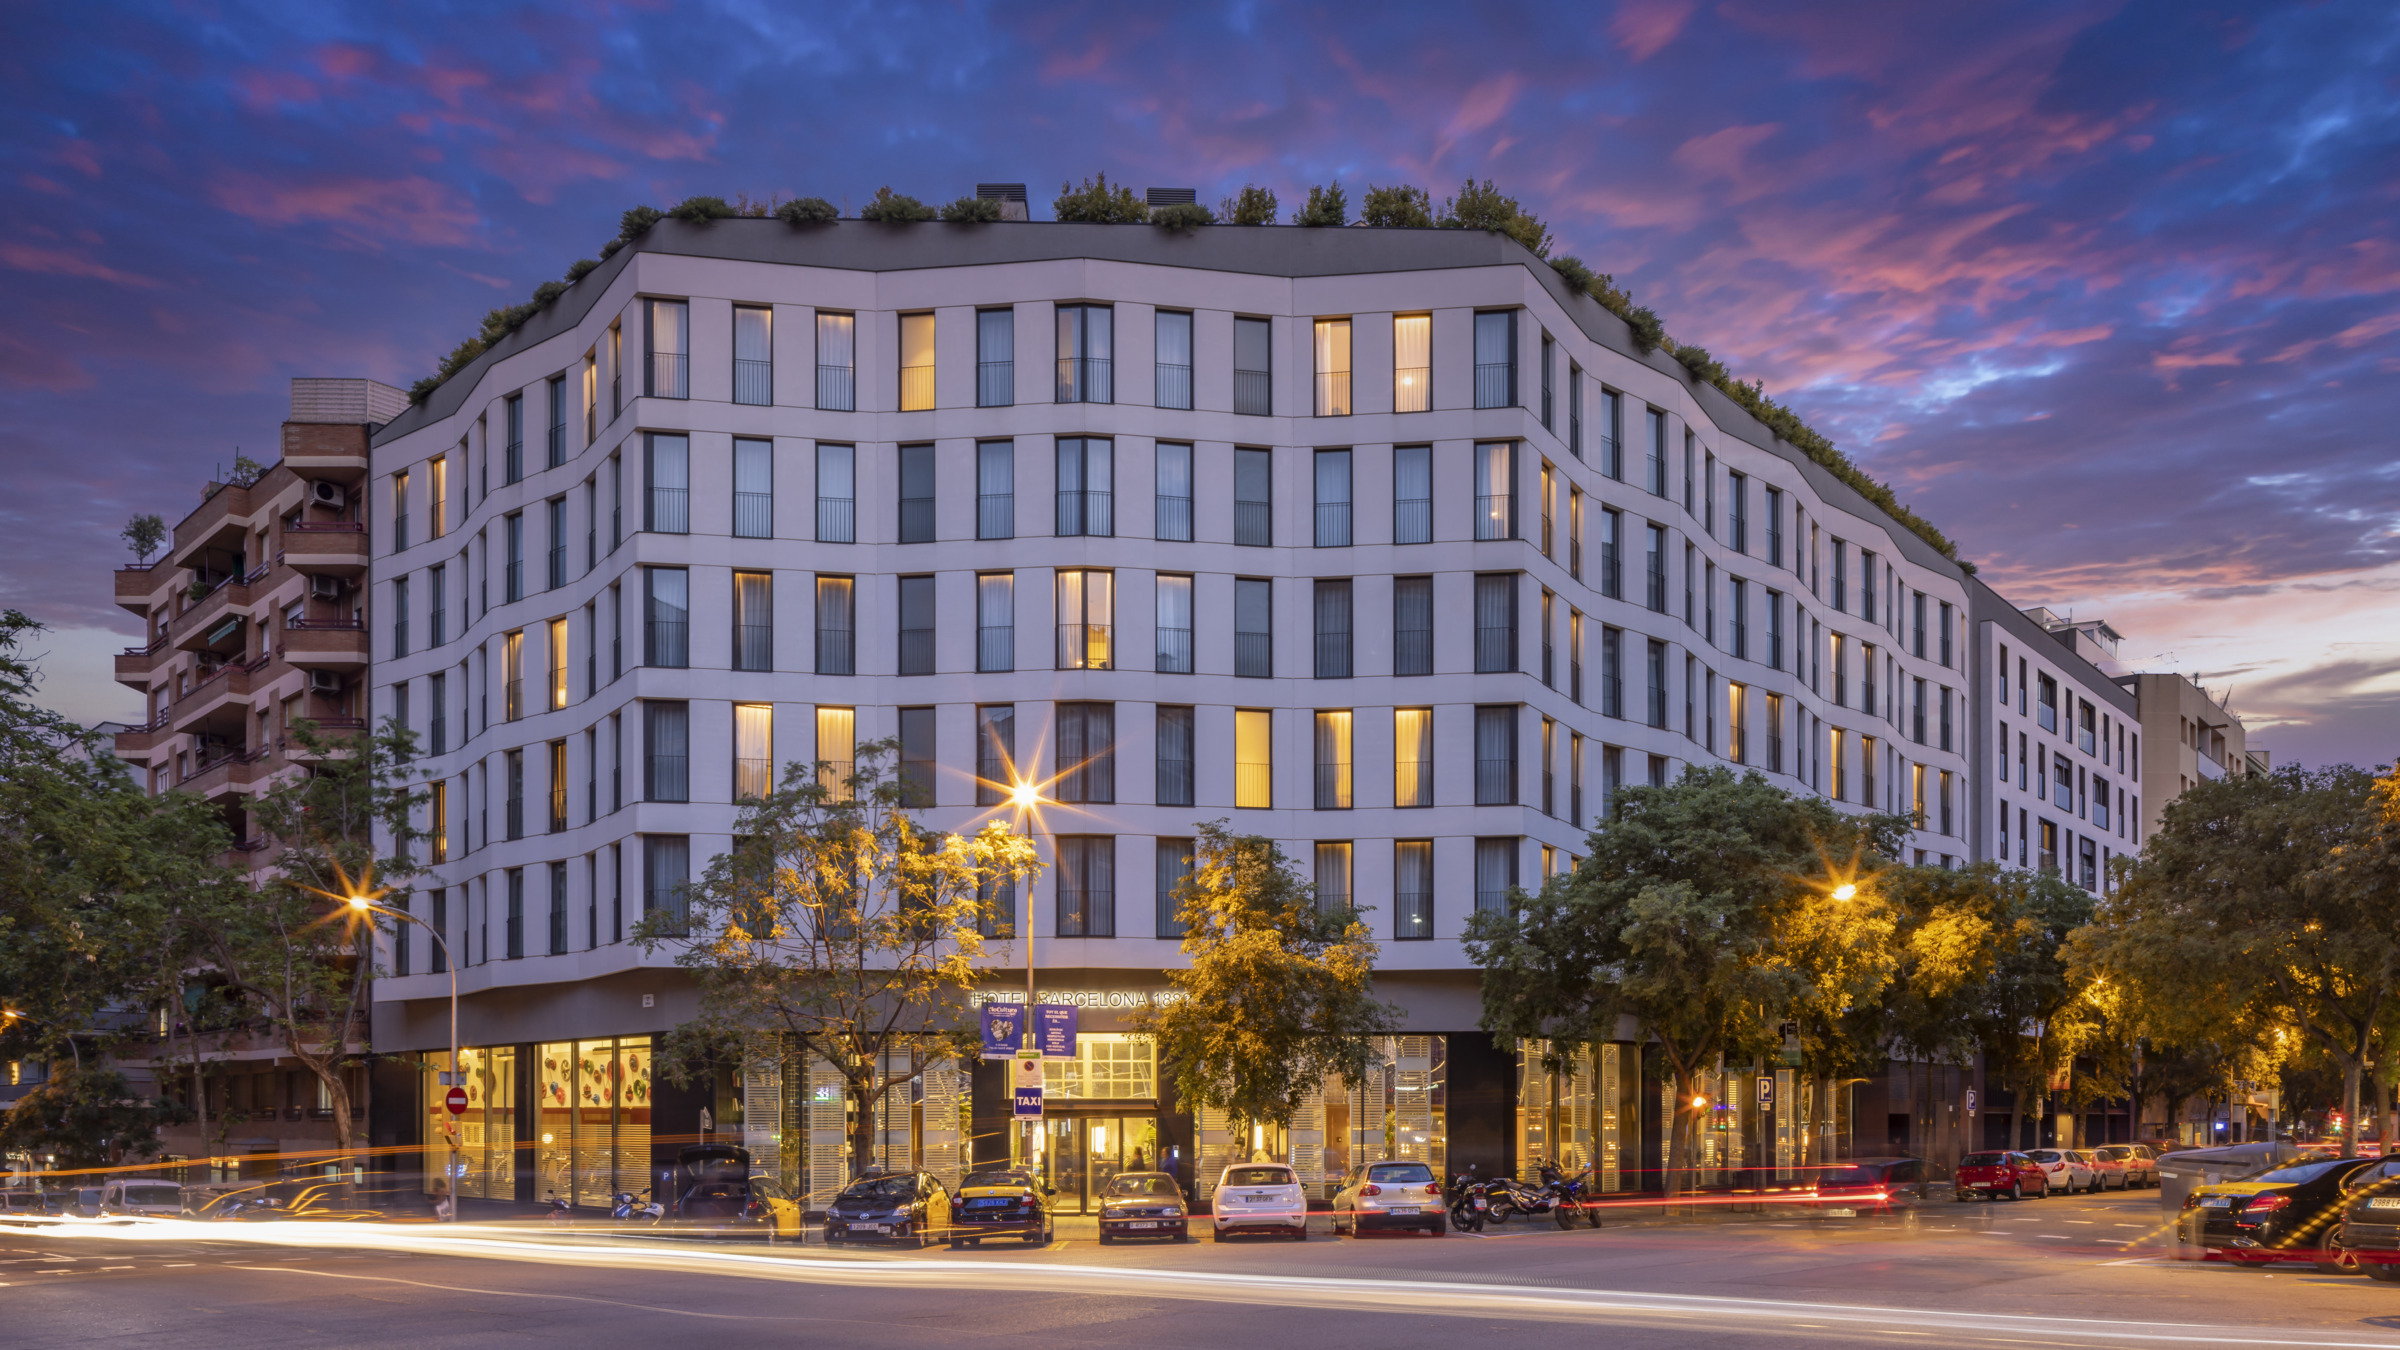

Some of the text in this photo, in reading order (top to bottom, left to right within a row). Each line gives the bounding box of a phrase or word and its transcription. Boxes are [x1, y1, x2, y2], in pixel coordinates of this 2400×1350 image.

[1037, 992, 1147, 1006] BARCELONA
[1760, 1081, 1770, 1100] P
[1017, 1097, 1041, 1106] TAXI
[1969, 1093, 1975, 1107] P
[663, 1172, 670, 1180] P
